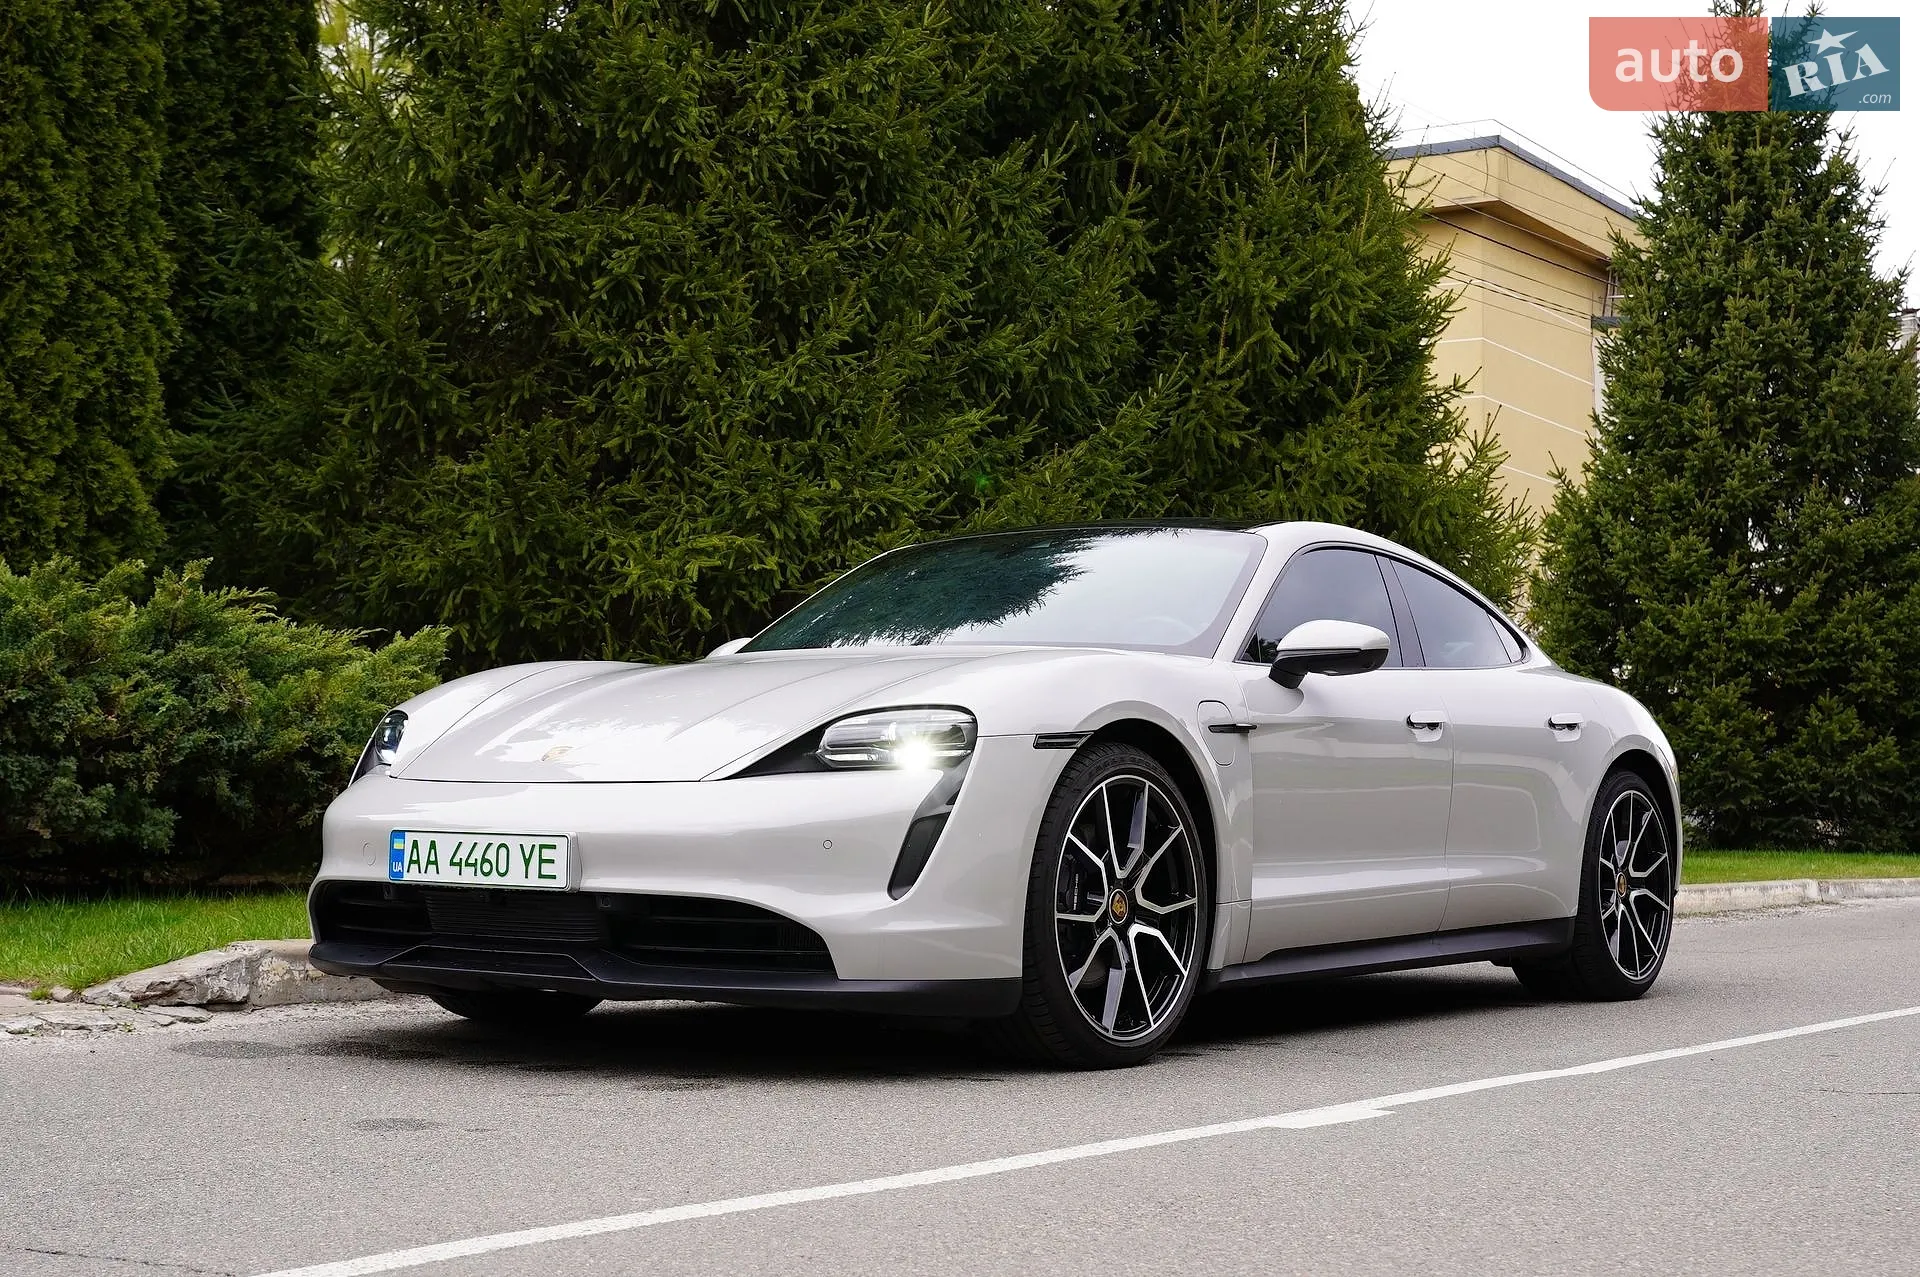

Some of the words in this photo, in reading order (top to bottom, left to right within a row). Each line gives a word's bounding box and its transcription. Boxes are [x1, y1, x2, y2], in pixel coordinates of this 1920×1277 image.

[392, 861, 403, 873] UA
[406, 839, 440, 875] AA
[449, 841, 510, 878] 4460
[519, 843, 557, 880] YE
